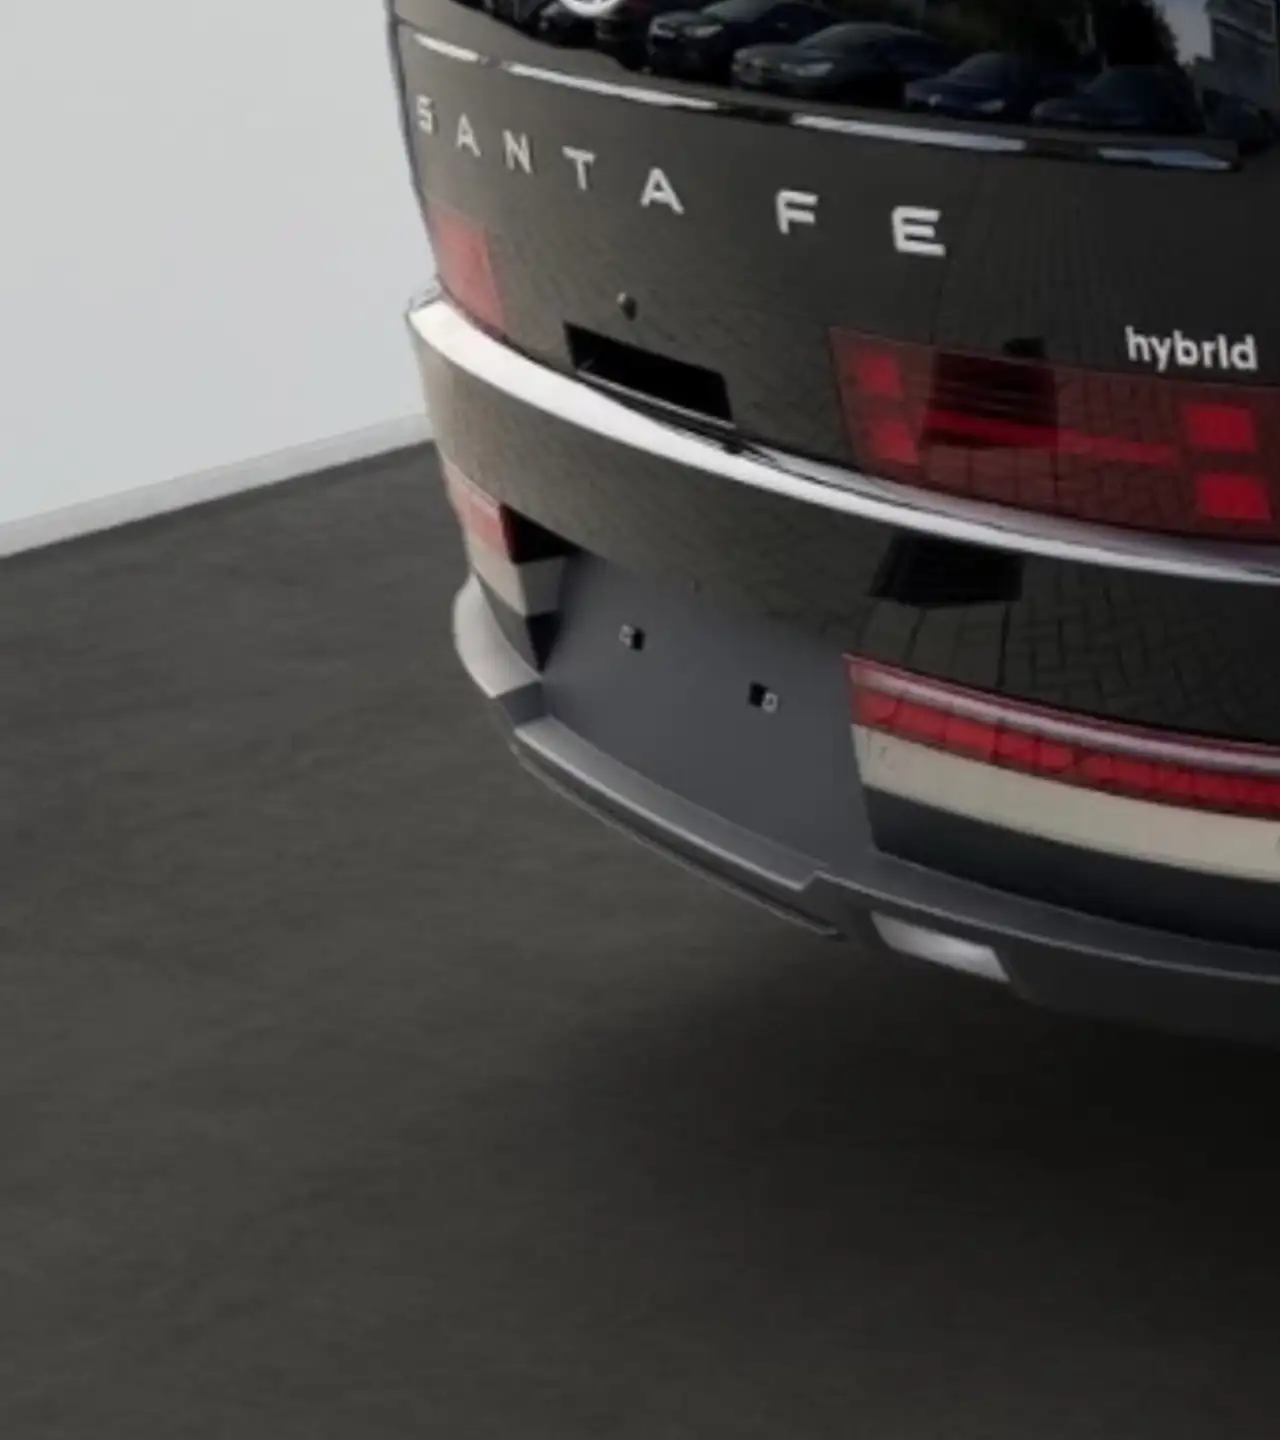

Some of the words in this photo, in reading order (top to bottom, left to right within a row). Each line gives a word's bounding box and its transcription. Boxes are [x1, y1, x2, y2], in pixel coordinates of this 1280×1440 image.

[414, 93, 685, 216] SANTA
[775, 189, 946, 258] FE
[1125, 325, 1258, 372] hybrid
